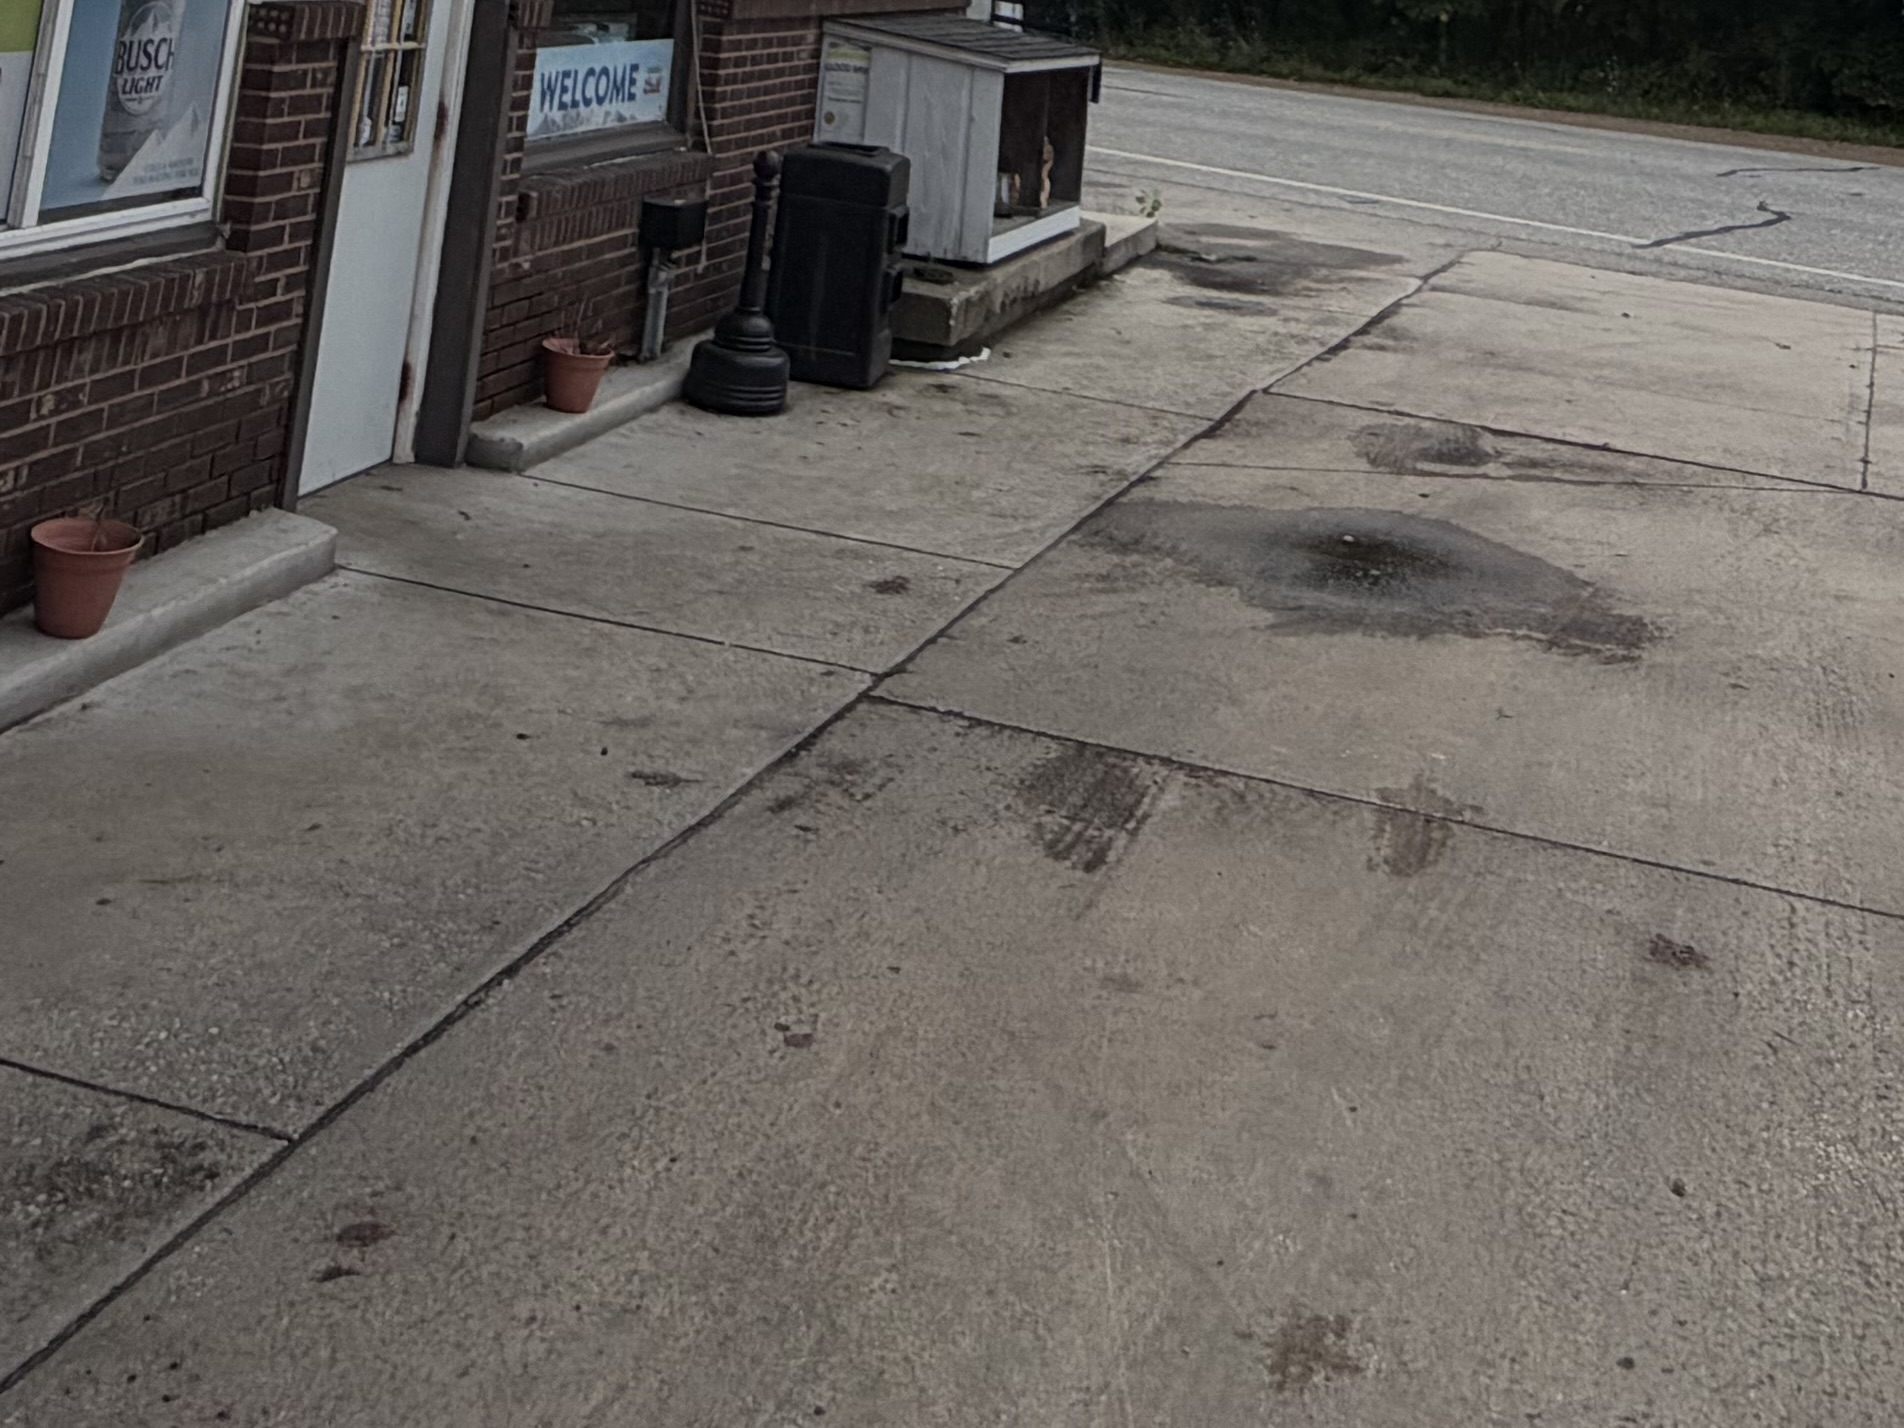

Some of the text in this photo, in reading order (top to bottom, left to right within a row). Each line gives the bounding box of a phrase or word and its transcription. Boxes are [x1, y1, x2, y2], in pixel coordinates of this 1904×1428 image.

[114, 36, 175, 75] BUSCH
[121, 74, 164, 95] LIGHT
[540, 63, 640, 113] WELCOME
